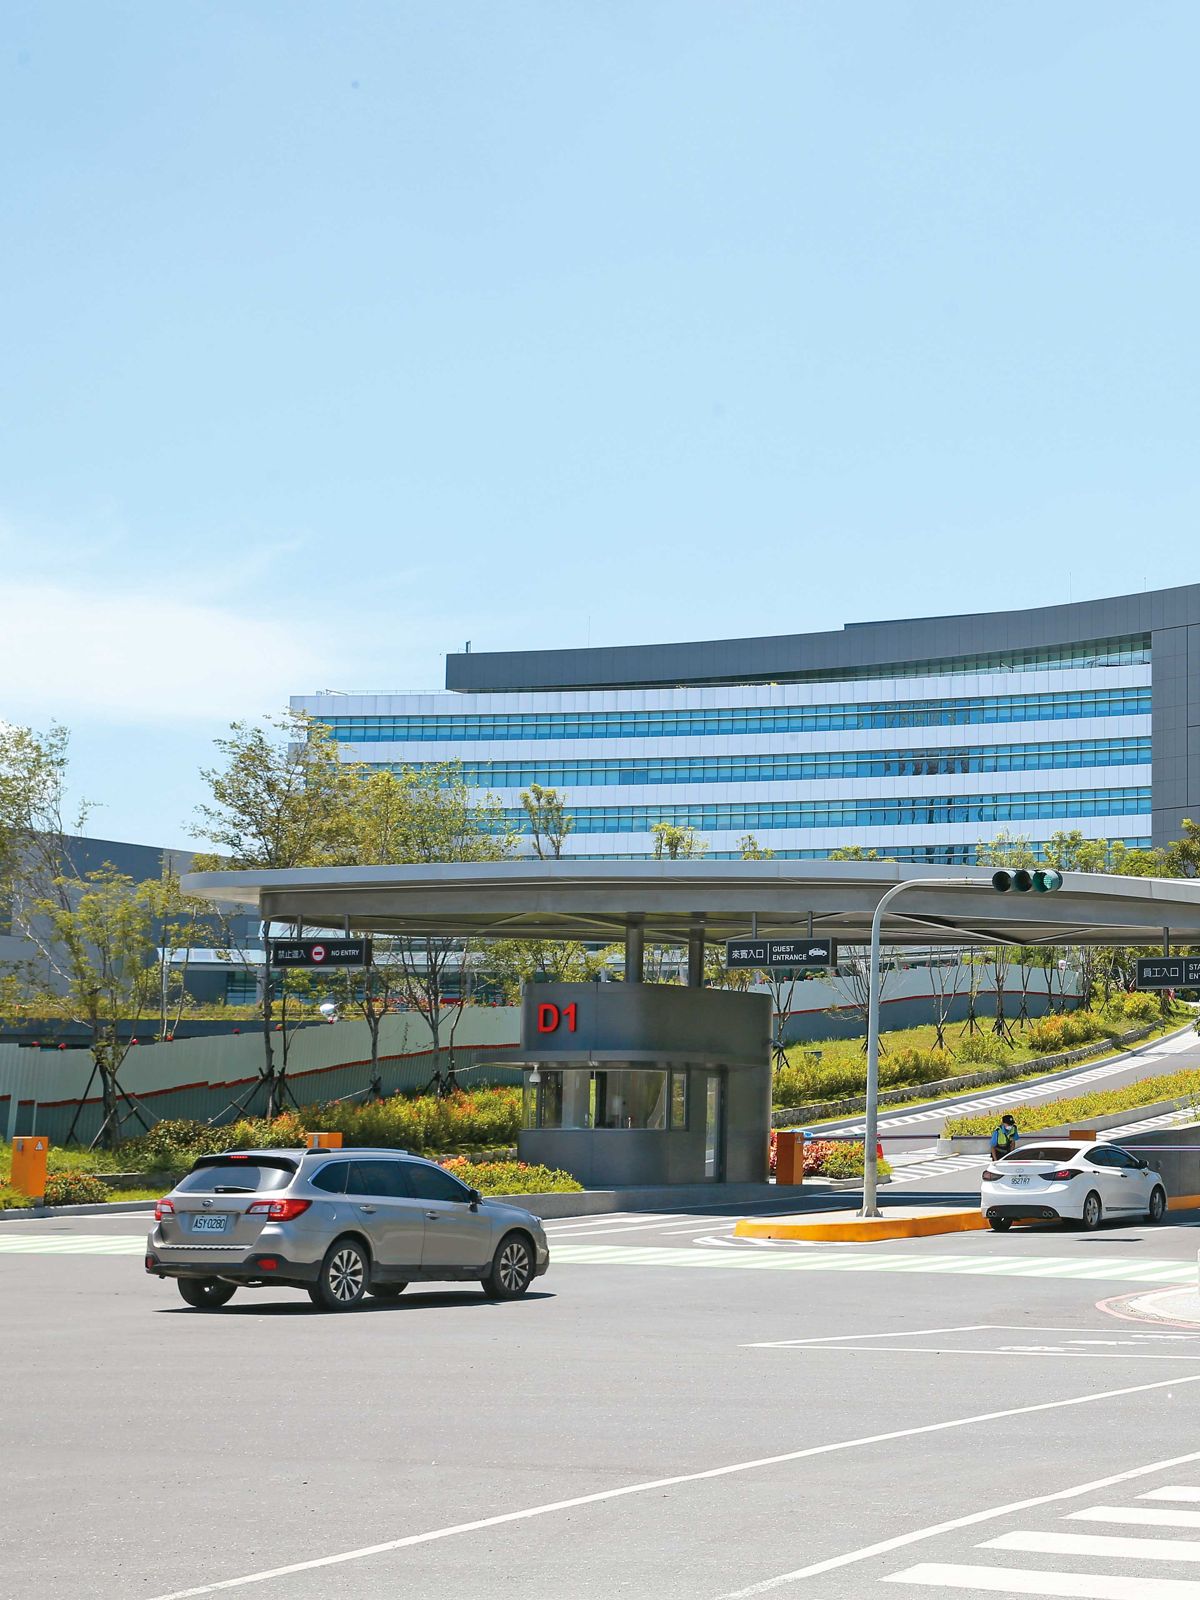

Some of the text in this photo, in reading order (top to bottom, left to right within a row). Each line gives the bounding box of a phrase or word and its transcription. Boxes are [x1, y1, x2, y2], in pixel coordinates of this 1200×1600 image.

[732, 949, 764, 959] 來賓入口
[772, 945, 794, 953] GUEST
[772, 953, 807, 961] ENTRANCE
[1143, 967, 1179, 978] 員工入口
[537, 1002, 577, 1033] D1
